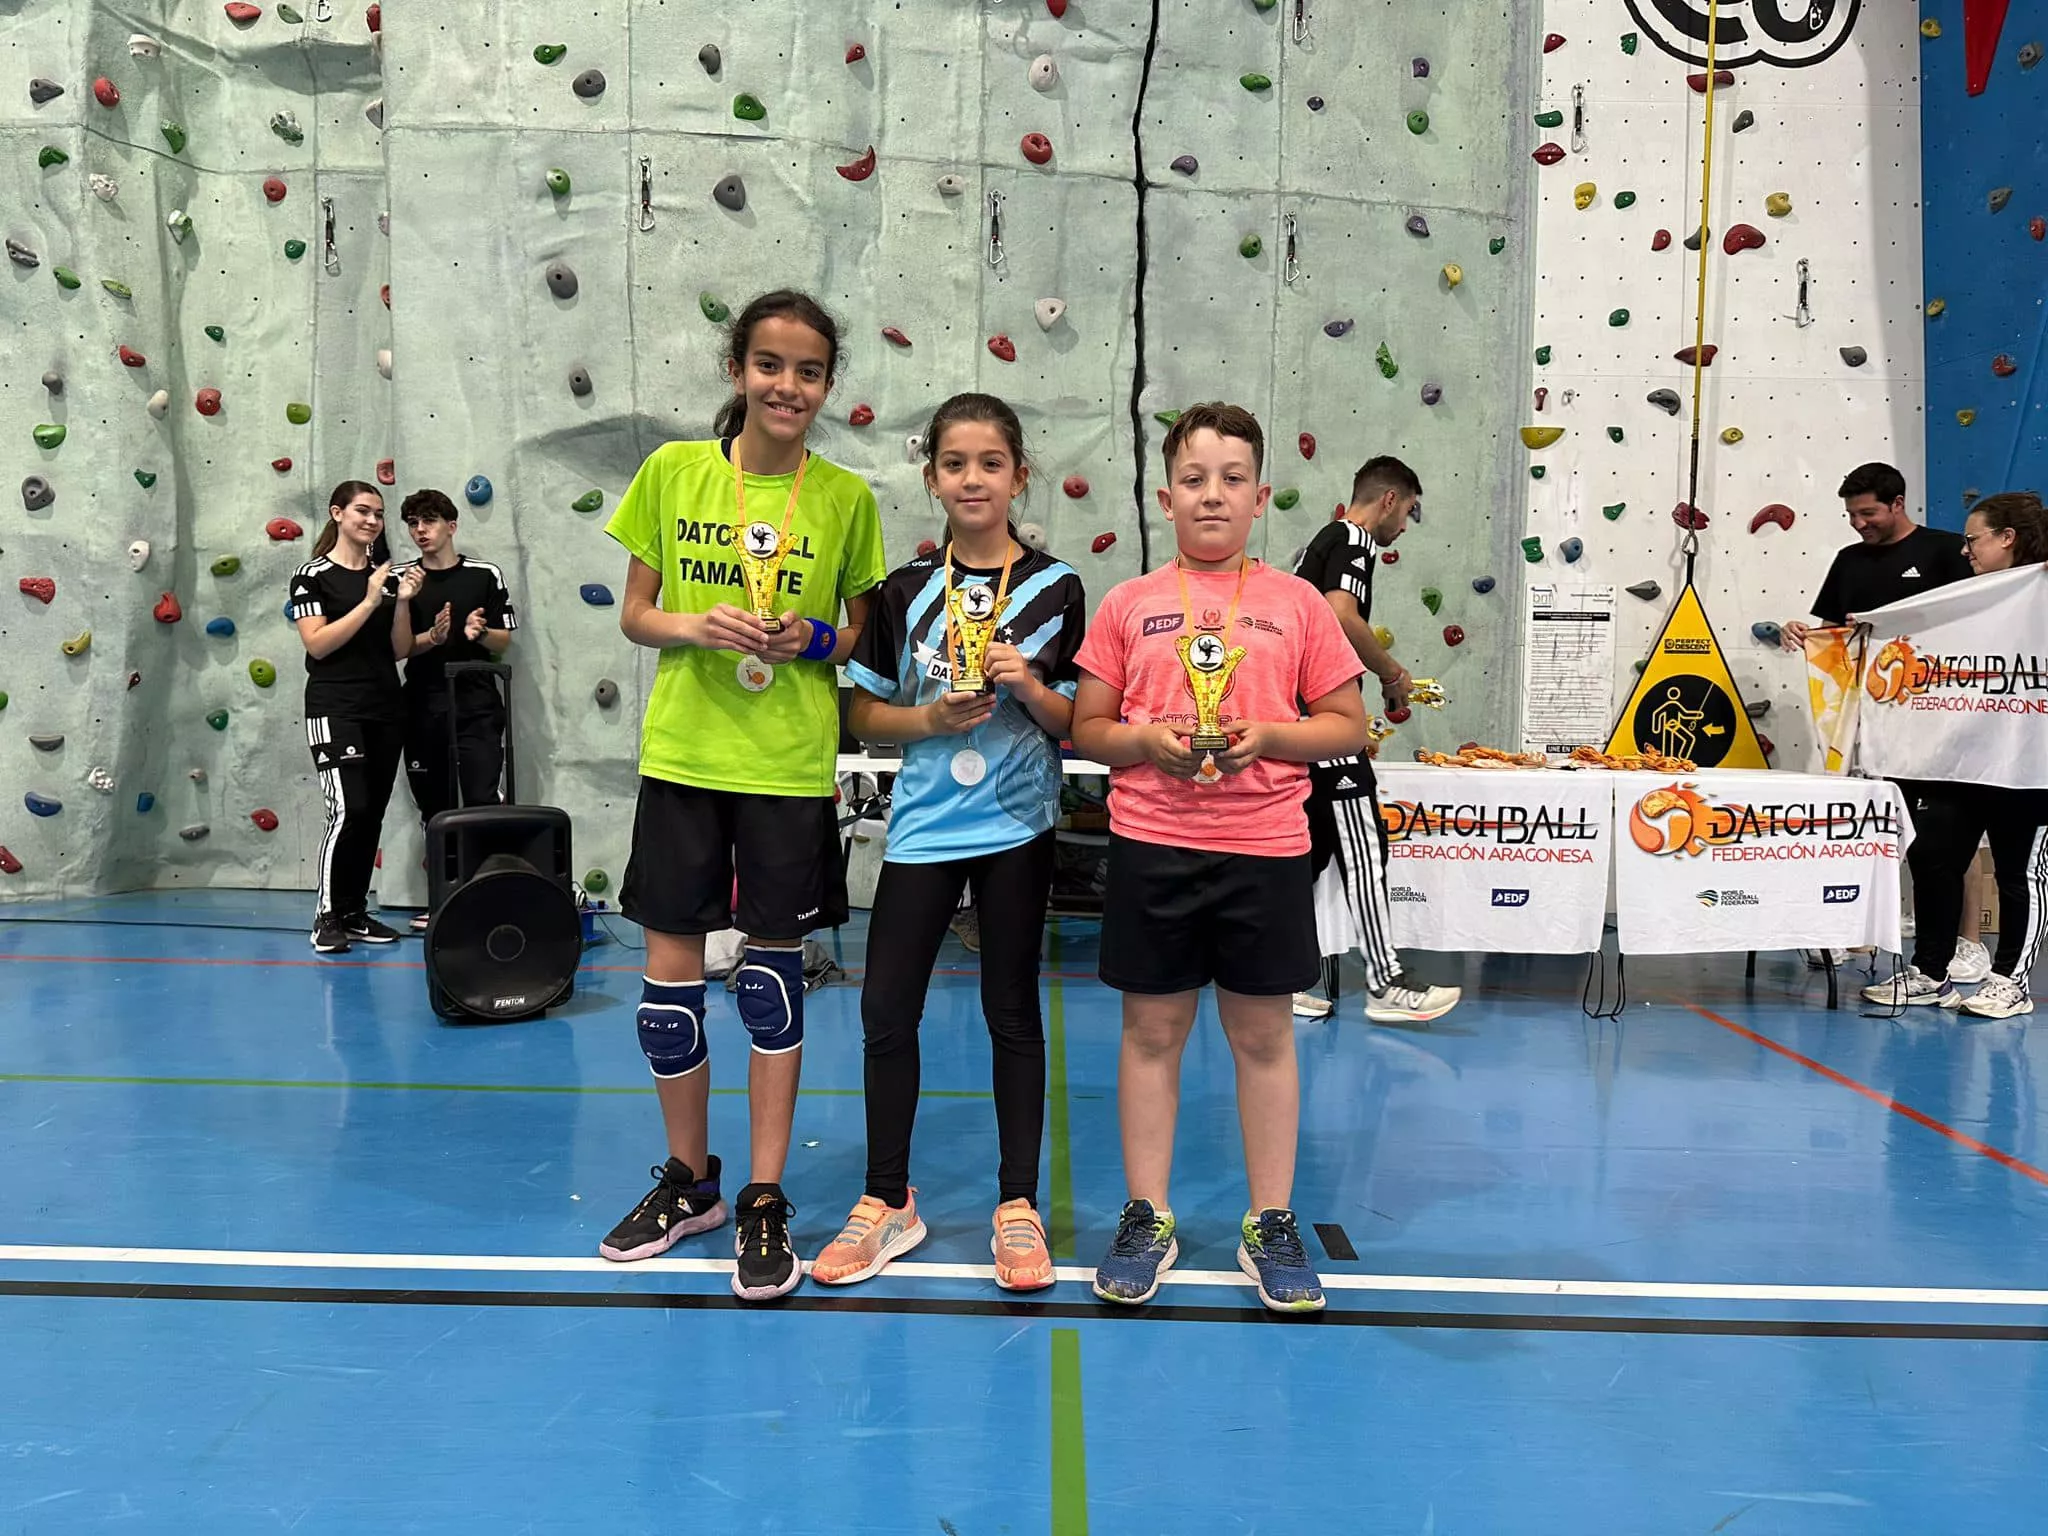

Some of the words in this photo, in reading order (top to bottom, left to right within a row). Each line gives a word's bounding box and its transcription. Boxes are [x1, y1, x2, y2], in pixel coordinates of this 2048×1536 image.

[677, 518, 815, 559] DATCL
[679, 557, 803, 595] TAMATE
[1155, 617, 1180, 630] EDF
[1911, 693, 1975, 712] FEDERACIÓN
[1547, 745, 1561, 753] UNE
[1381, 801, 1599, 845] DATCHBALL
[1488, 847, 1594, 863] ARAGONESA
[1712, 841, 1815, 862] FEDERACIÓN
[1503, 892, 1527, 904] EDF
[1835, 888, 1857, 900] EDF
[494, 995, 525, 1009] FENTON
